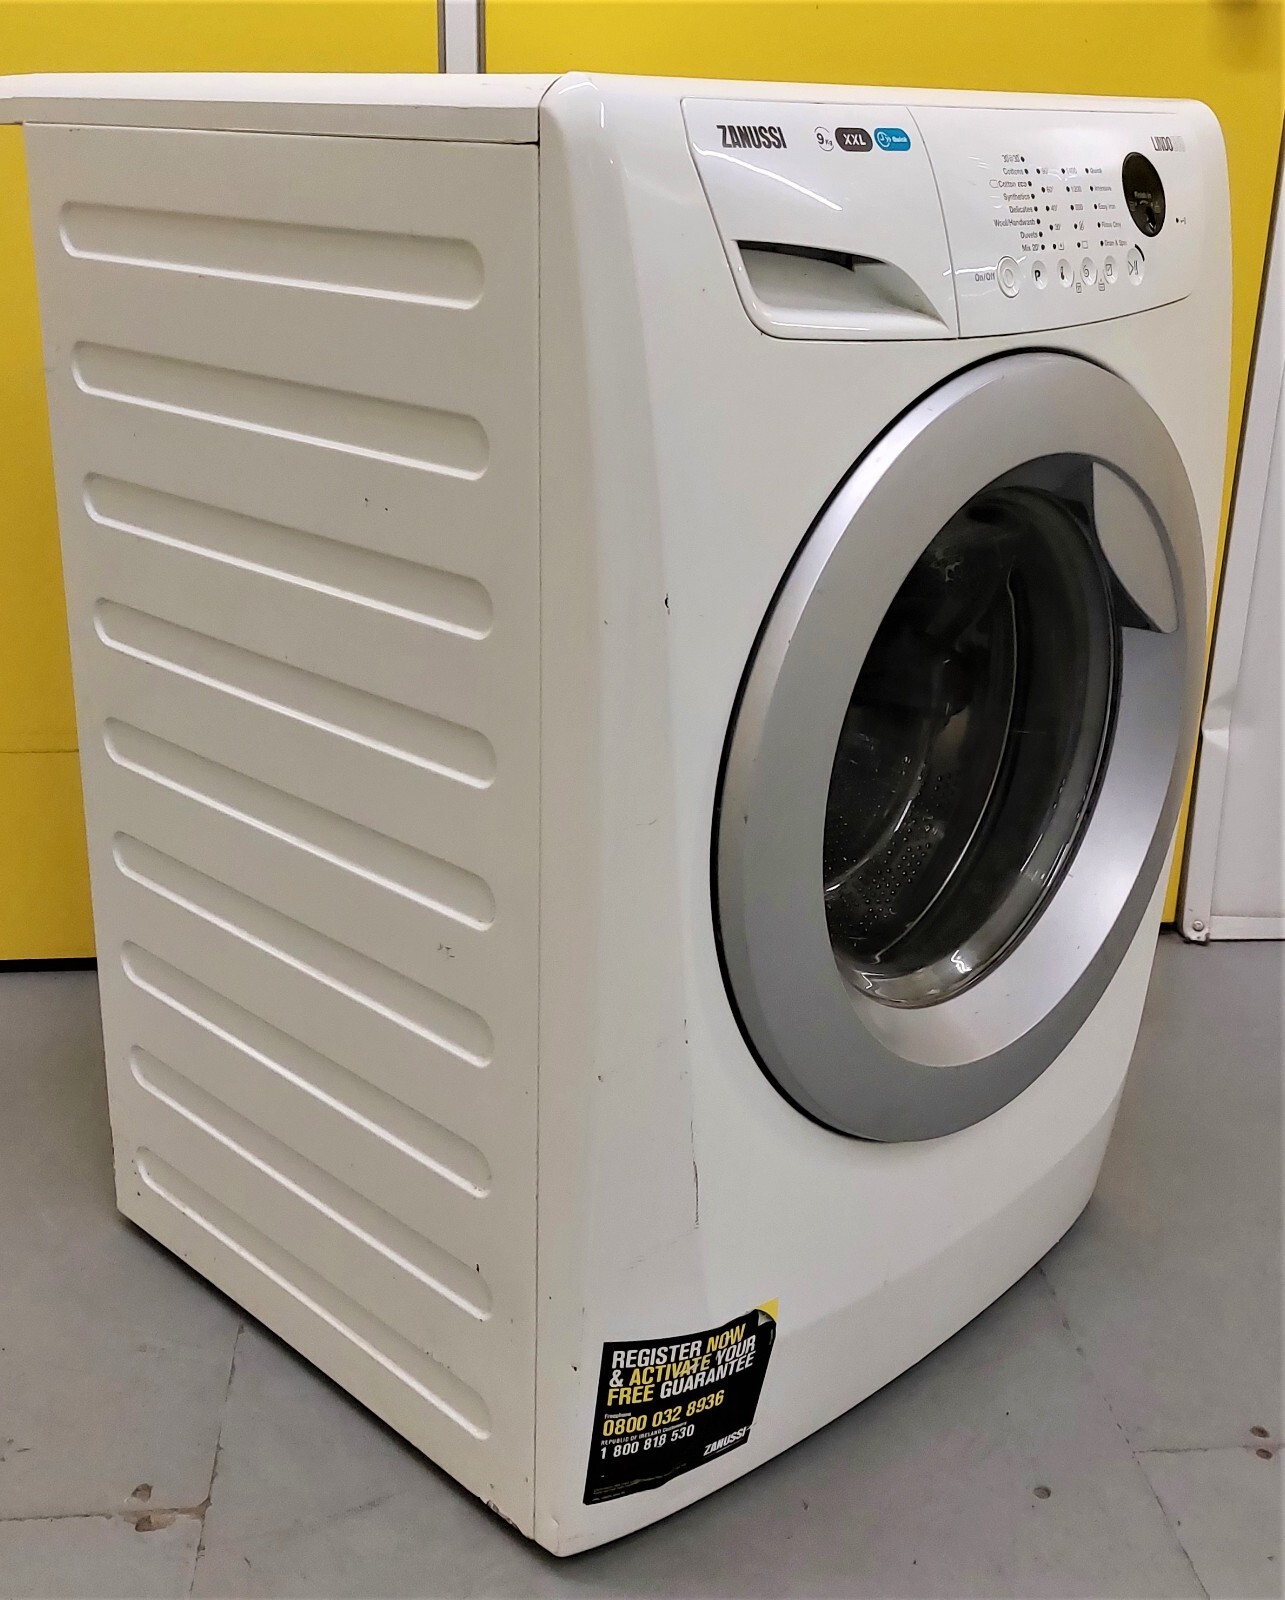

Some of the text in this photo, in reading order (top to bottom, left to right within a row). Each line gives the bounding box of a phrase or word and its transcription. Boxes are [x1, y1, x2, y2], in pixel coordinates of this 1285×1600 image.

[716, 125, 787, 149] ZANUSSI
[843, 134, 867, 146] XXL
[1020, 231, 1037, 239] Duvets
[975, 273, 996, 282] On/Off
[1034, 270, 1041, 281] P
[611, 1340, 702, 1369] REGISTER
[706, 1323, 747, 1353] NOW
[608, 1369, 624, 1387] &
[629, 1353, 712, 1387] ACTIVATE
[715, 1335, 757, 1364] YOUR
[607, 1351, 757, 1406] FREE GUARANTEE
[602, 1389, 725, 1437] 0800 032 8936
[600, 1436, 630, 1446] REPUBLIC
[601, 1424, 695, 1460] 1 800 818 530
[703, 1426, 747, 1457] ZANUSSI
